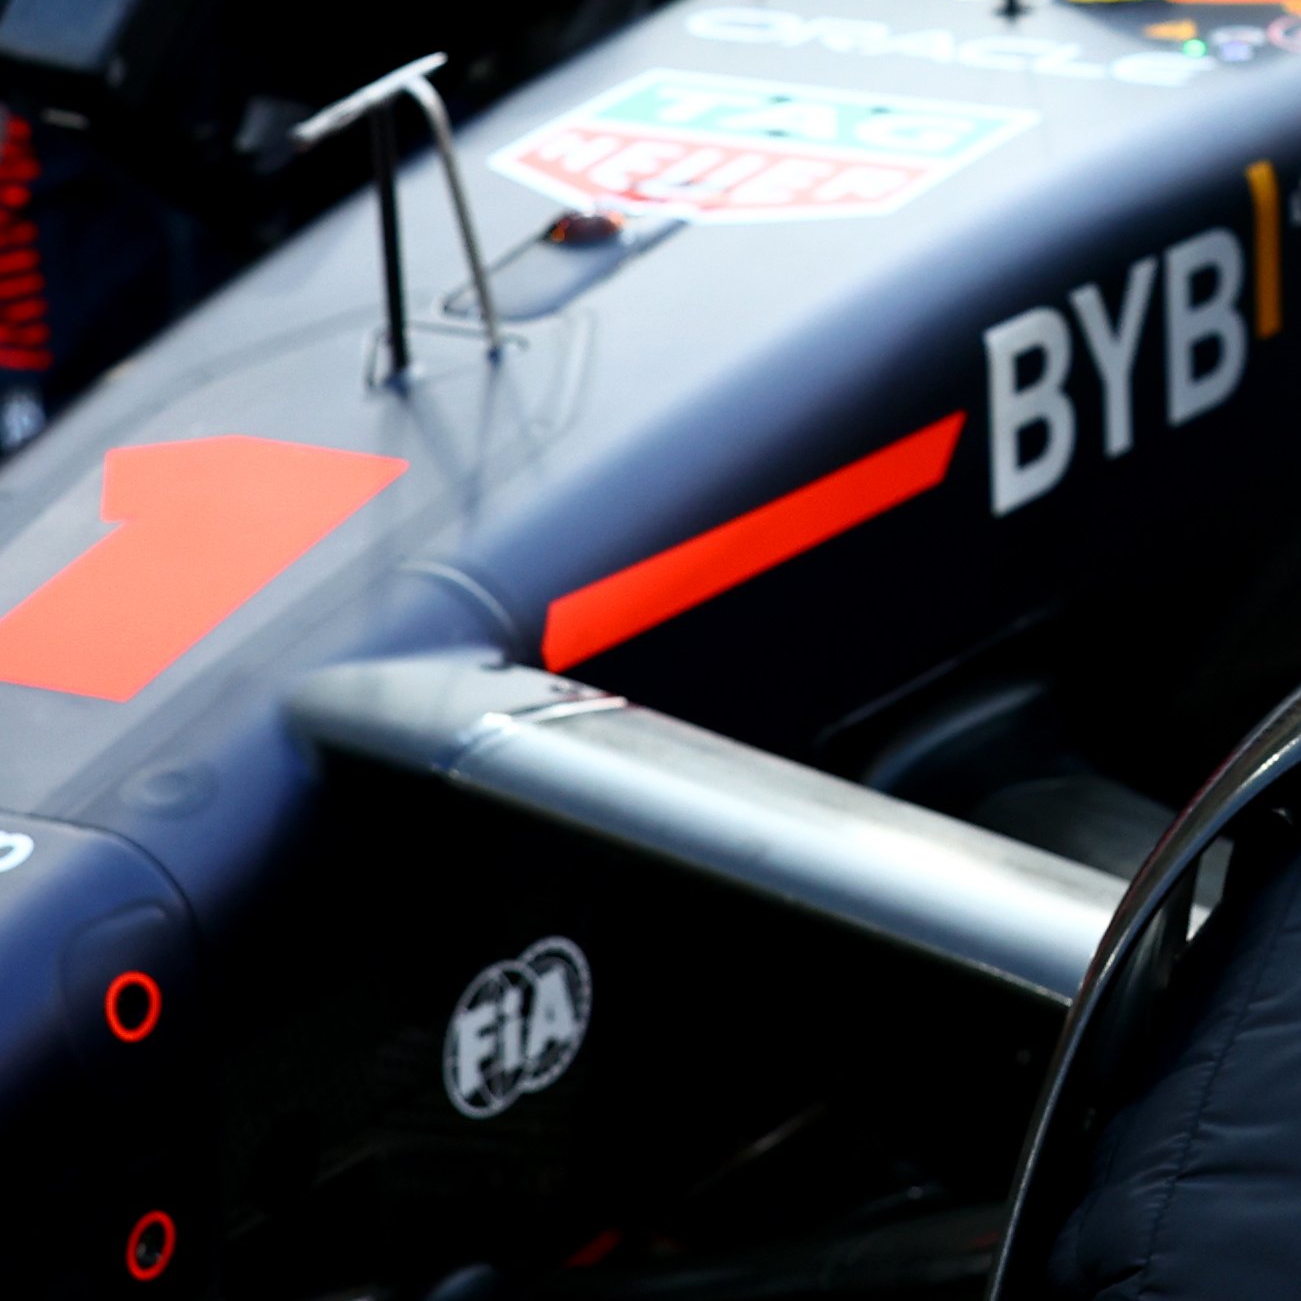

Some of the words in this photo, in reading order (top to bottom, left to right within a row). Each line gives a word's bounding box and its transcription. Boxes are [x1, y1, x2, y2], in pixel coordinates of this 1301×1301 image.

[685, 7, 1216, 86] ORACLE
[655, 88, 975, 154] TAG
[536, 130, 912, 206] HEUER
[0, 434, 409, 704] 1
